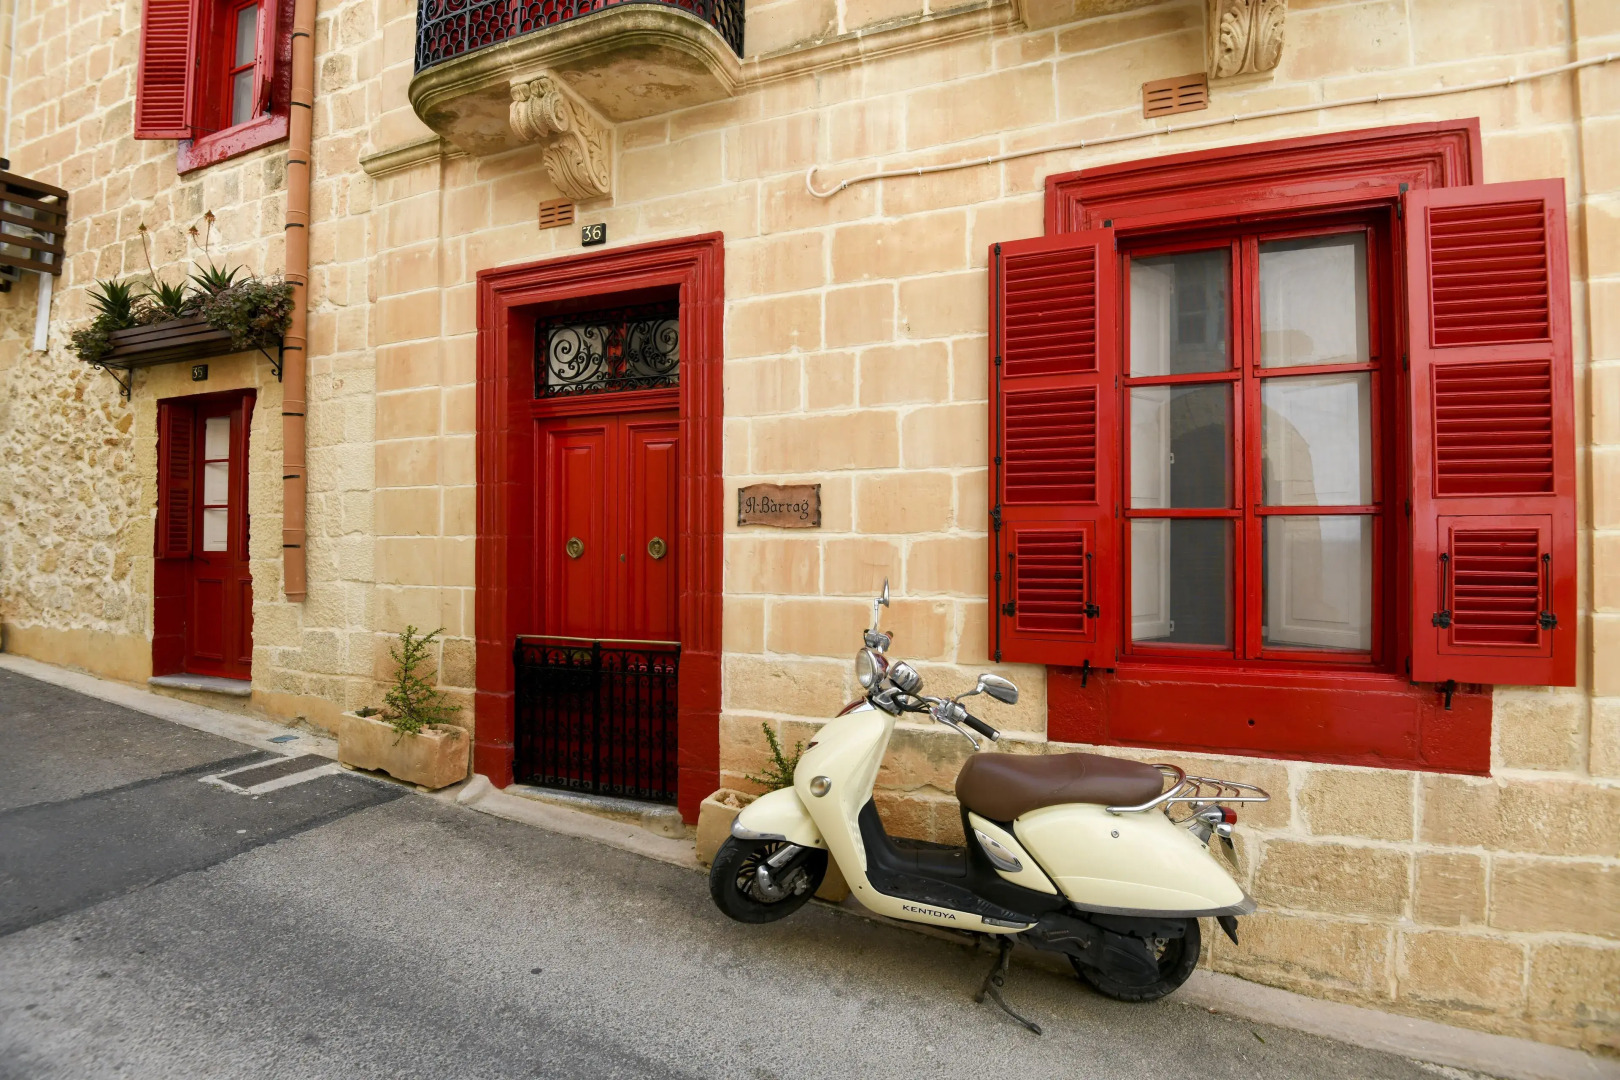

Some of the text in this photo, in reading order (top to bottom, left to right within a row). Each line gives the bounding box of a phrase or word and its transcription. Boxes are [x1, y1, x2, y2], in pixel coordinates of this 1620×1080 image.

[582, 225, 601, 241] 36
[192, 366, 203, 379] 35
[902, 904, 956, 920] KENTOYA
